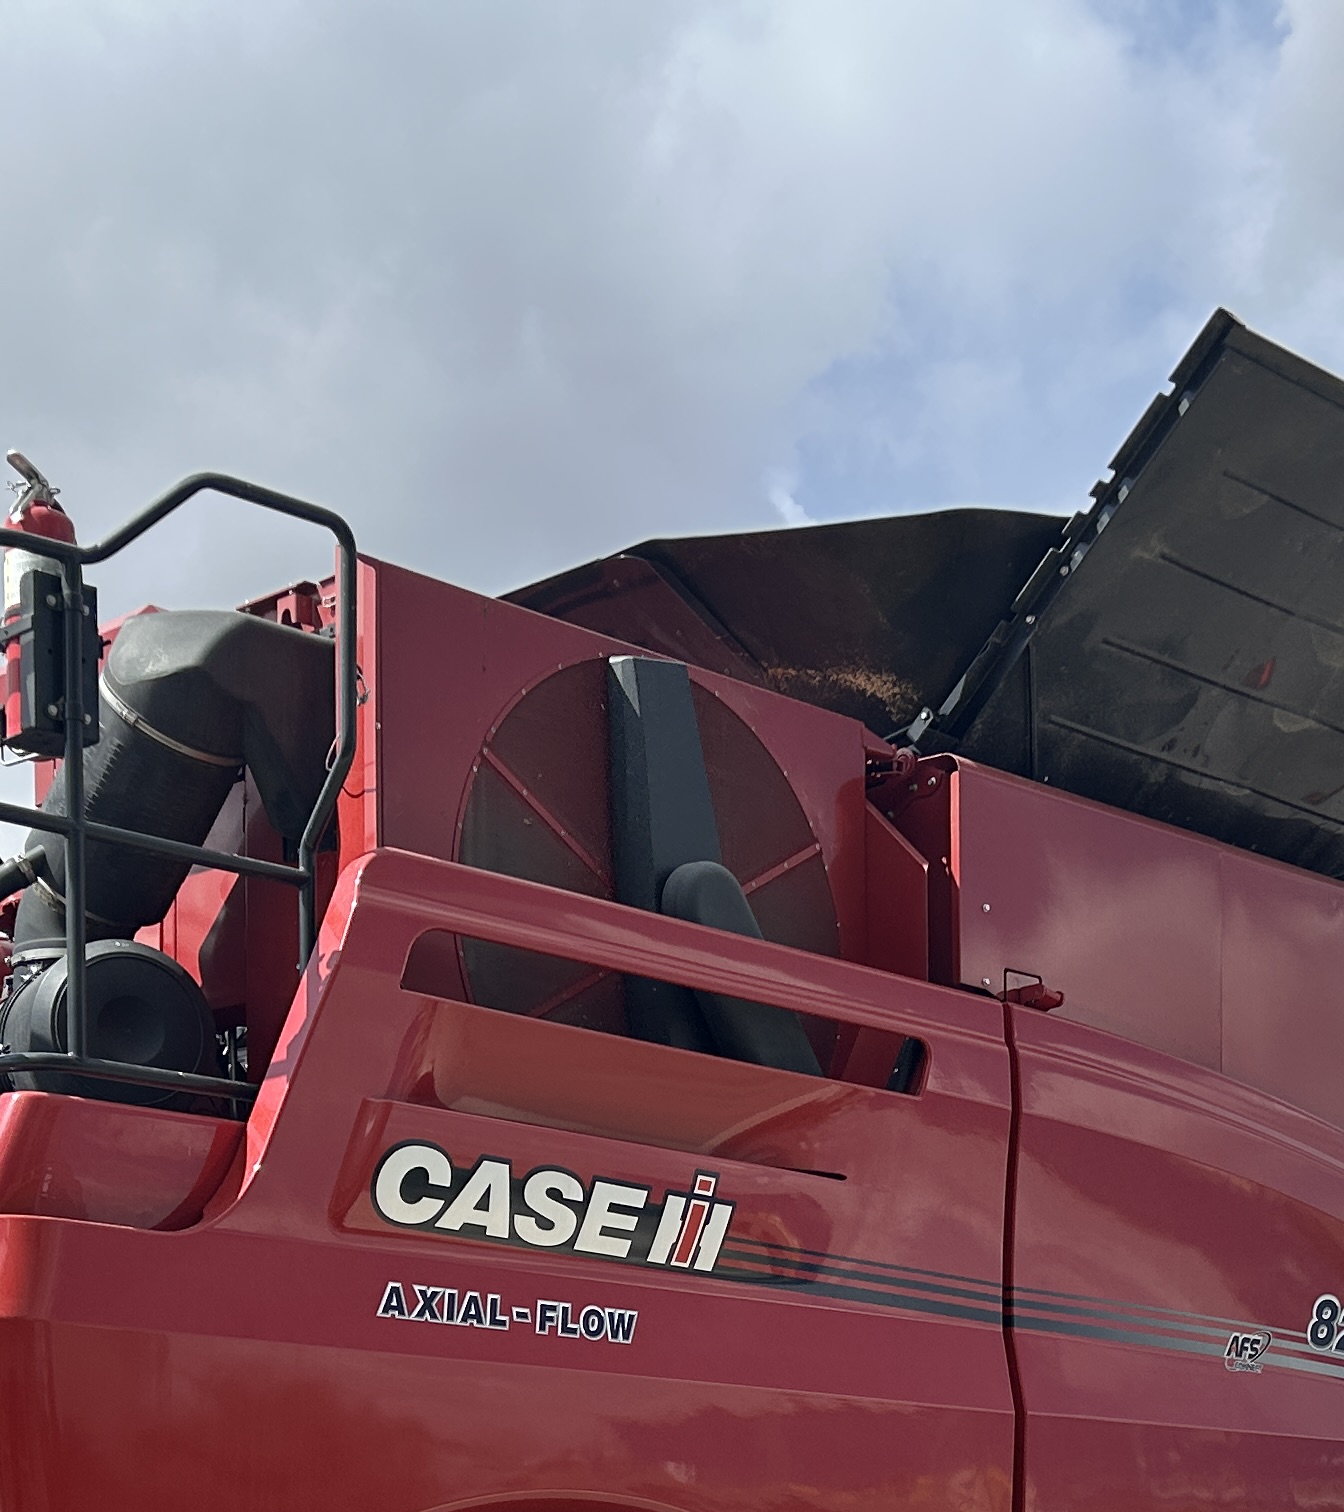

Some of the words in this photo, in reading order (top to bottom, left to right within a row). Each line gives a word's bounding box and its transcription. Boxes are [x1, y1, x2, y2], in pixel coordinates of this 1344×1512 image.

[375, 1144, 648, 1260] CASE
[376, 1281, 639, 1345] AXIAL-FLOW
[1225, 1334, 1261, 1359] AFS
